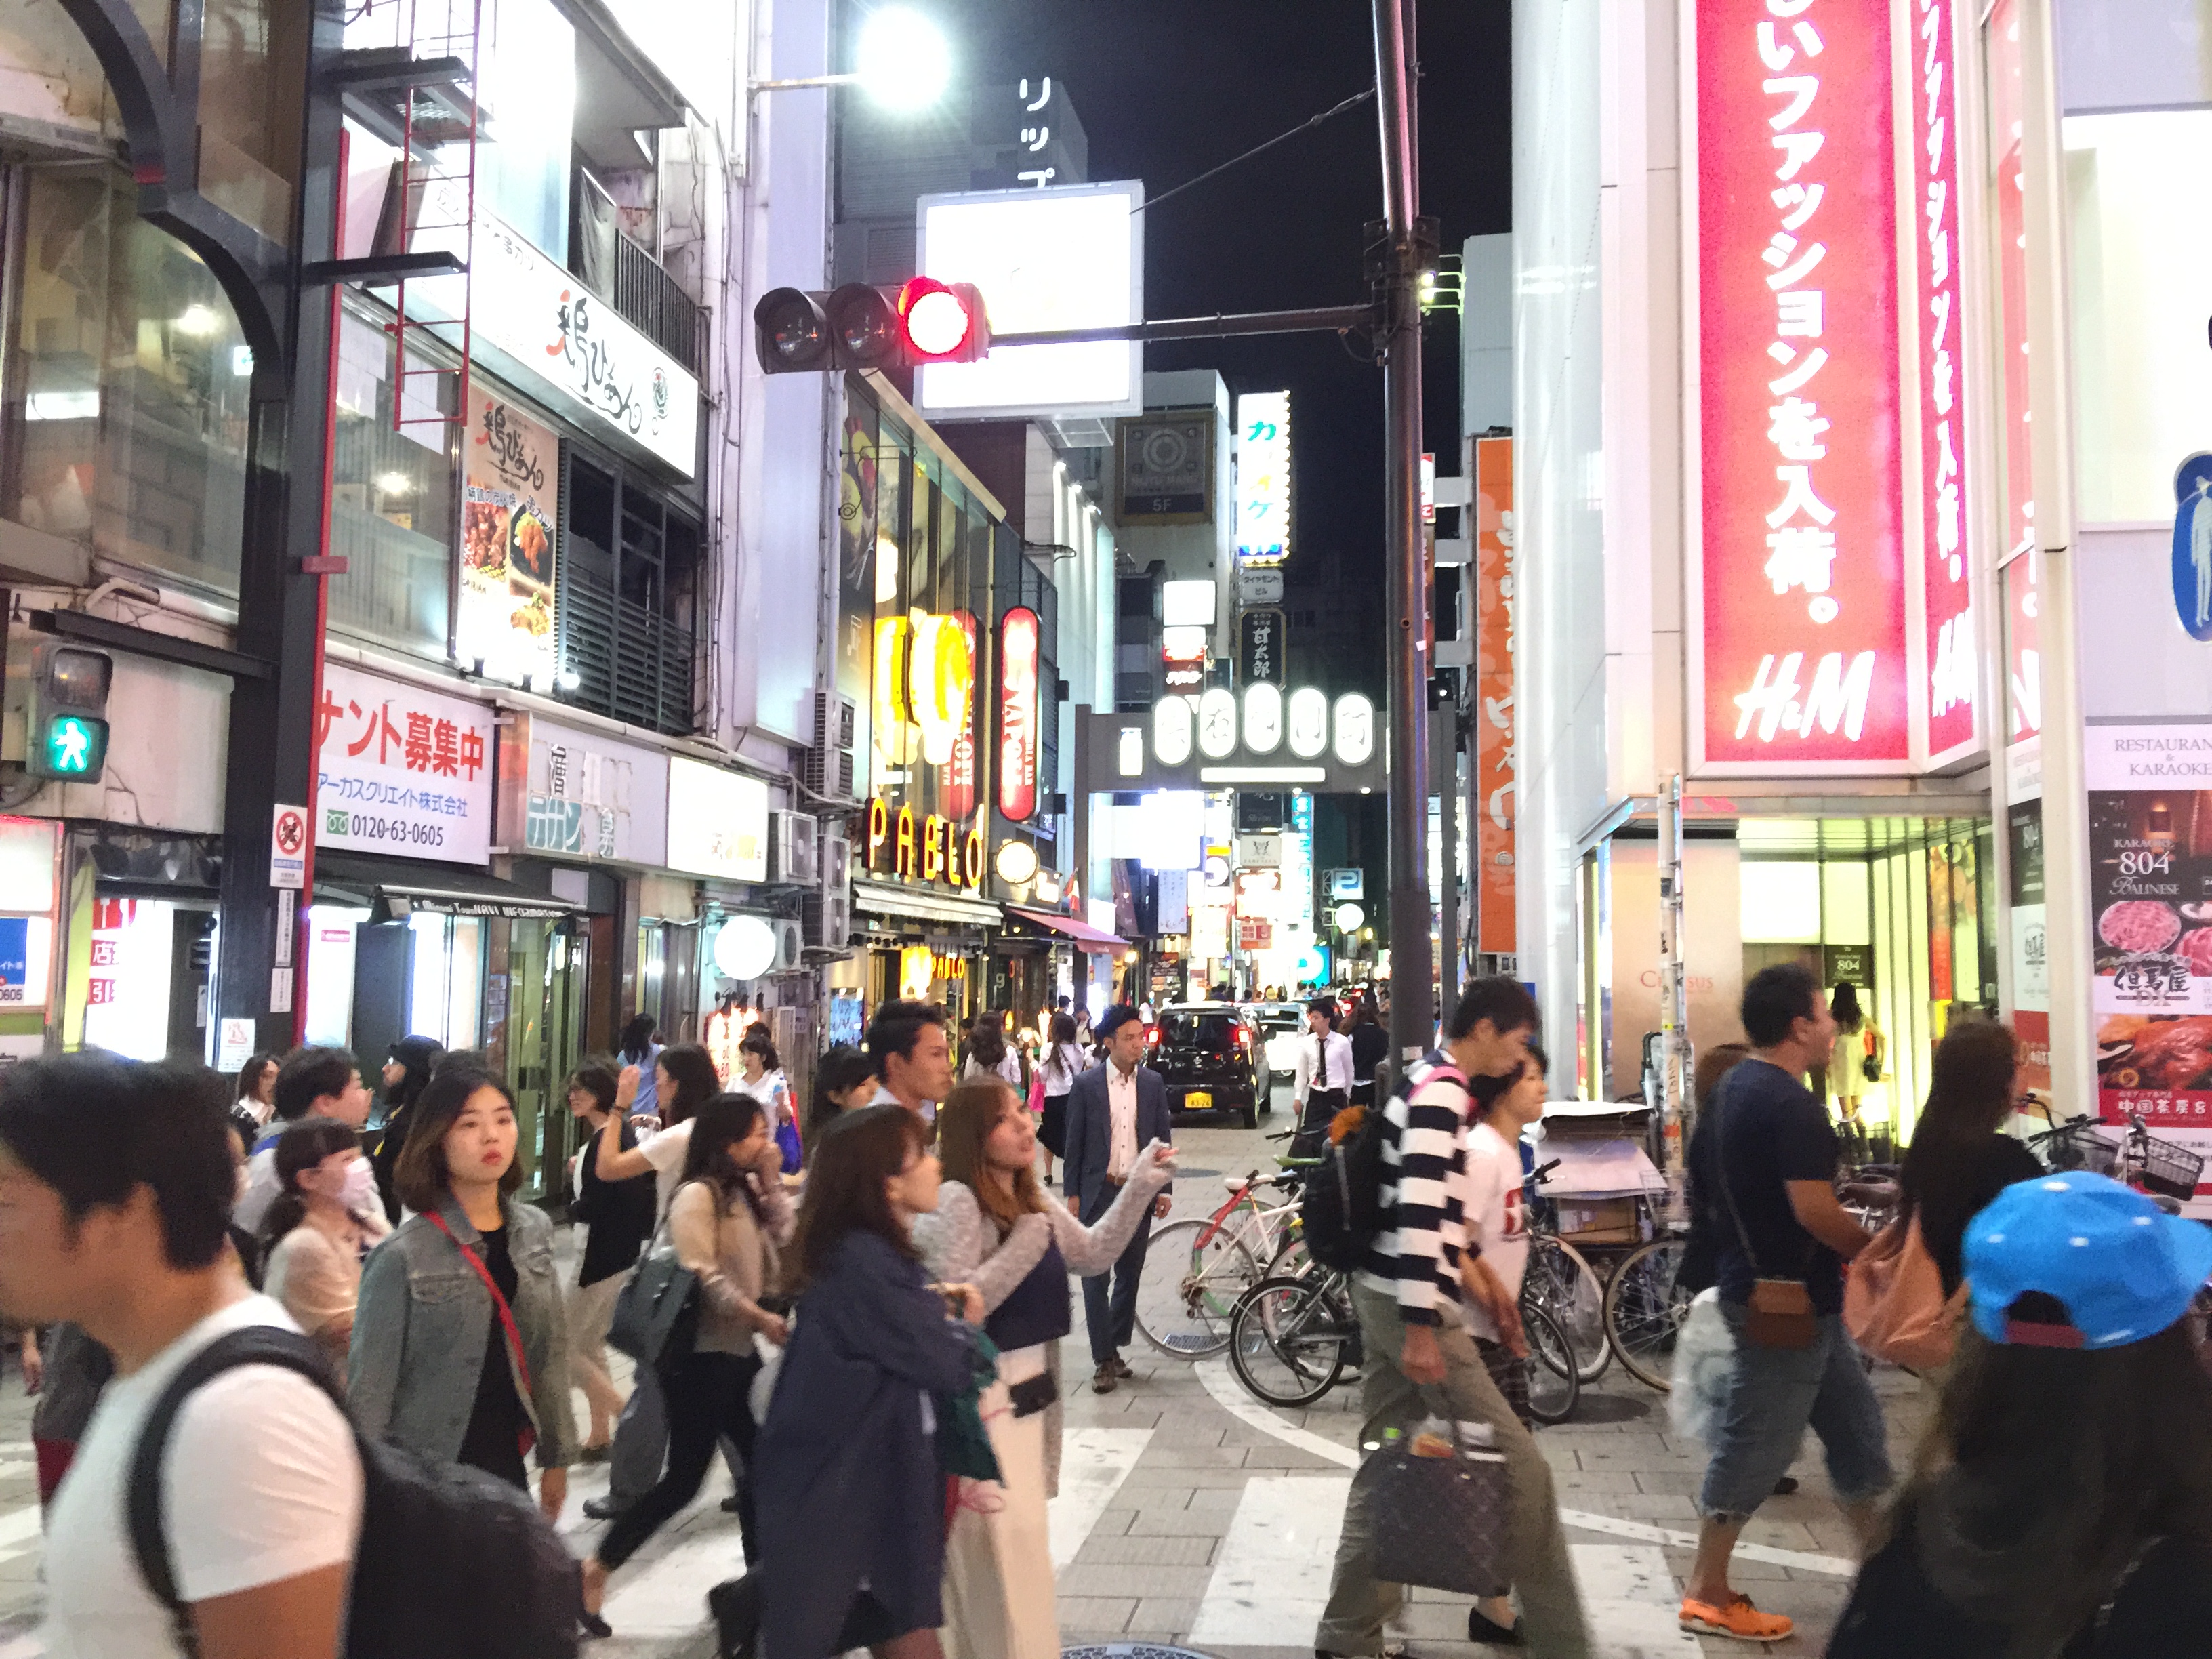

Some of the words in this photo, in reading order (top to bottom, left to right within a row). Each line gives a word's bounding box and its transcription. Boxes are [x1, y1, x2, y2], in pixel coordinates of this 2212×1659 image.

[1247, 421, 1277, 519] カオケ
[1153, 498, 1172, 512] 5F
[1252, 627, 1271, 678] 甘太郎
[1732, 651, 1877, 743] H&M
[2129, 763, 2212, 776] KARAOKE
[352, 814, 444, 846] 0120-63-0605
[868, 797, 983, 888] PABLO
[2113, 839, 2175, 848] KARAOKE
[2119, 851, 2170, 875] 804
[931, 956, 965, 979] PABLO
[1837, 960, 1860, 970] 804
